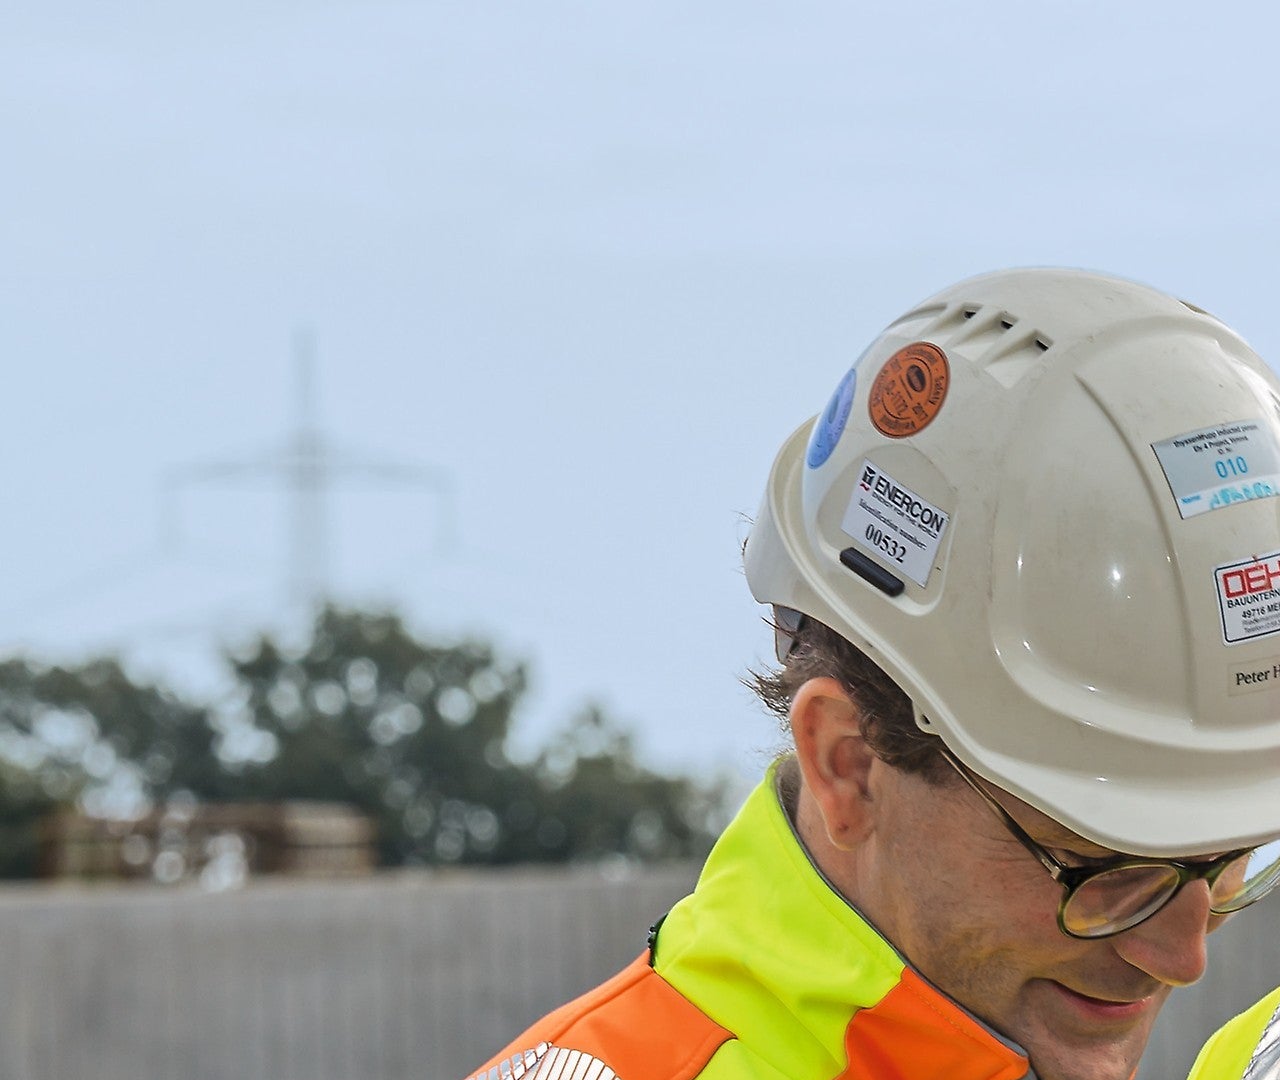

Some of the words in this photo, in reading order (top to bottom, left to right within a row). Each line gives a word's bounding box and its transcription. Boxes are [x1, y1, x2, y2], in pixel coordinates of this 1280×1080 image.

[1215, 456, 1249, 479] 010
[874, 475, 944, 533] ENERCON
[865, 523, 907, 564] 00532
[1235, 669, 1271, 686] Peter
